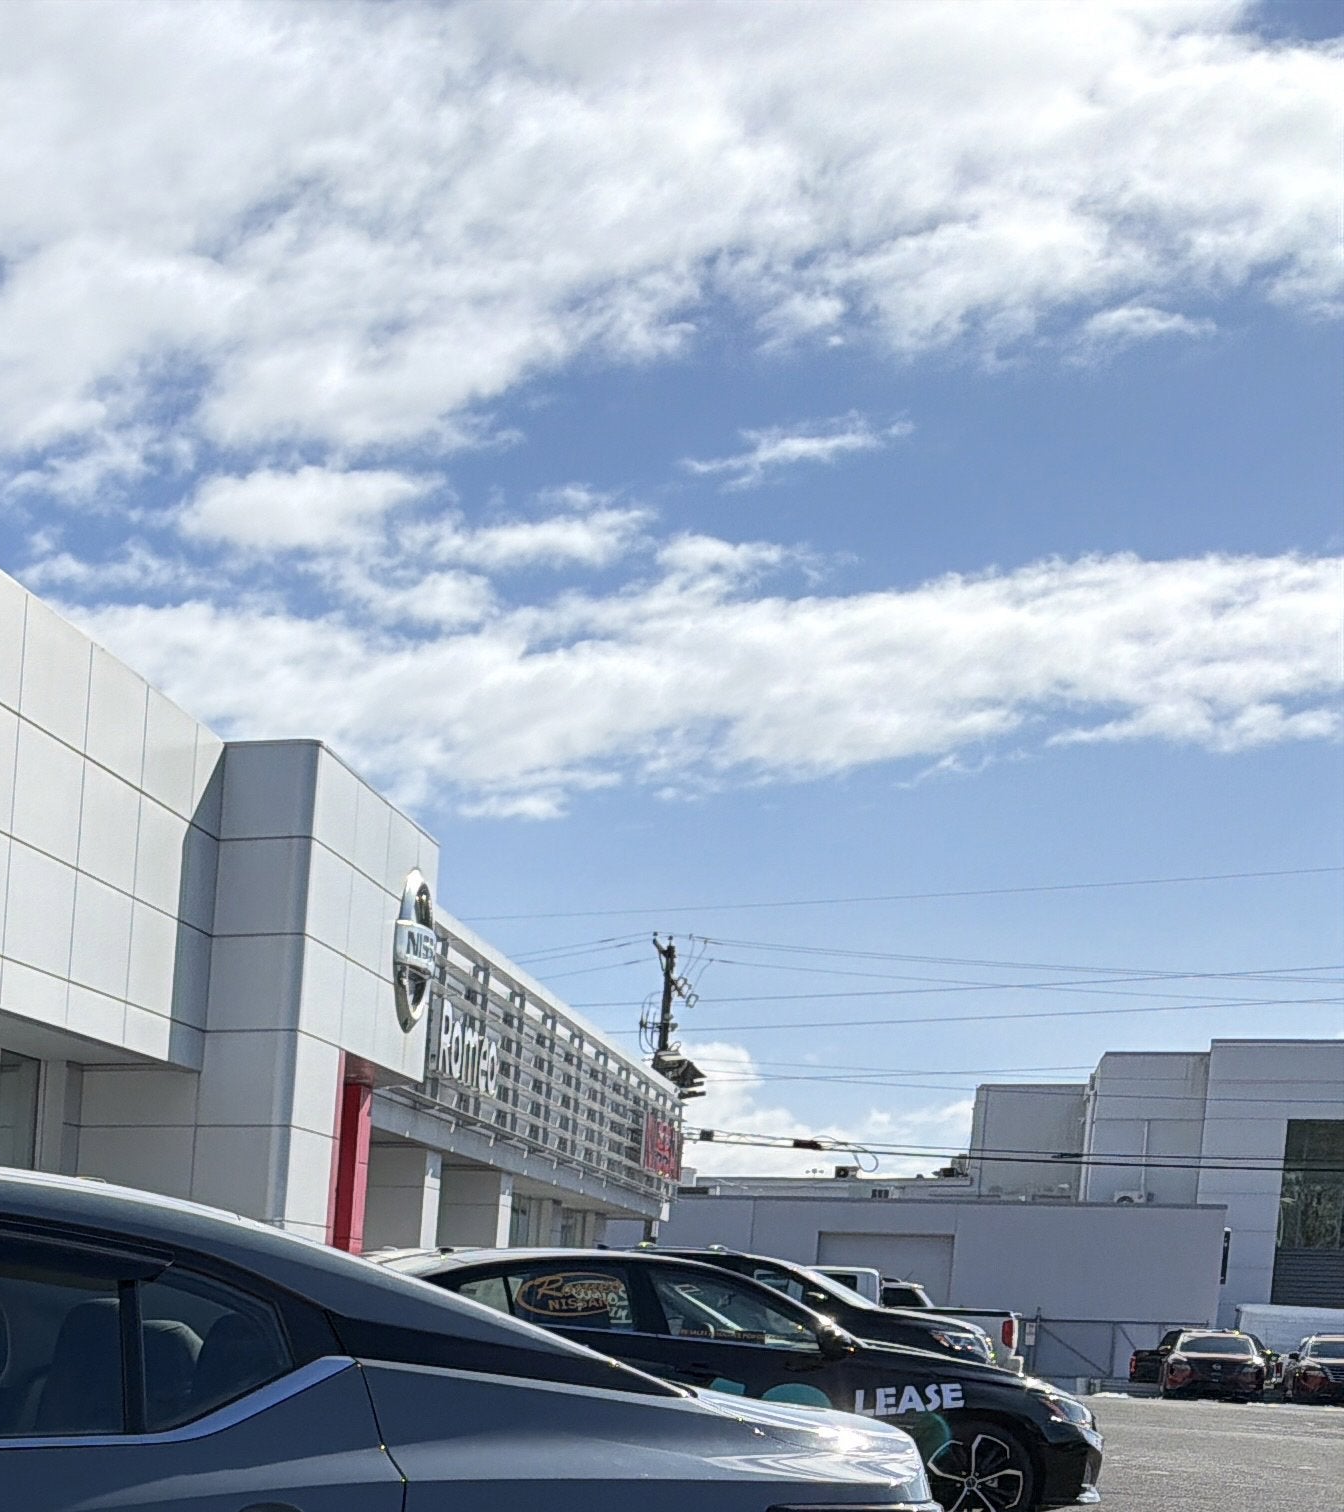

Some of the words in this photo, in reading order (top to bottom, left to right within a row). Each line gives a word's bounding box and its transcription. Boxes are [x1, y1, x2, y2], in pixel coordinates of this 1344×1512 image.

[406, 931, 434, 962] NISS
[438, 998, 499, 1097] Romeo
[854, 1383, 965, 1416] LEASE
